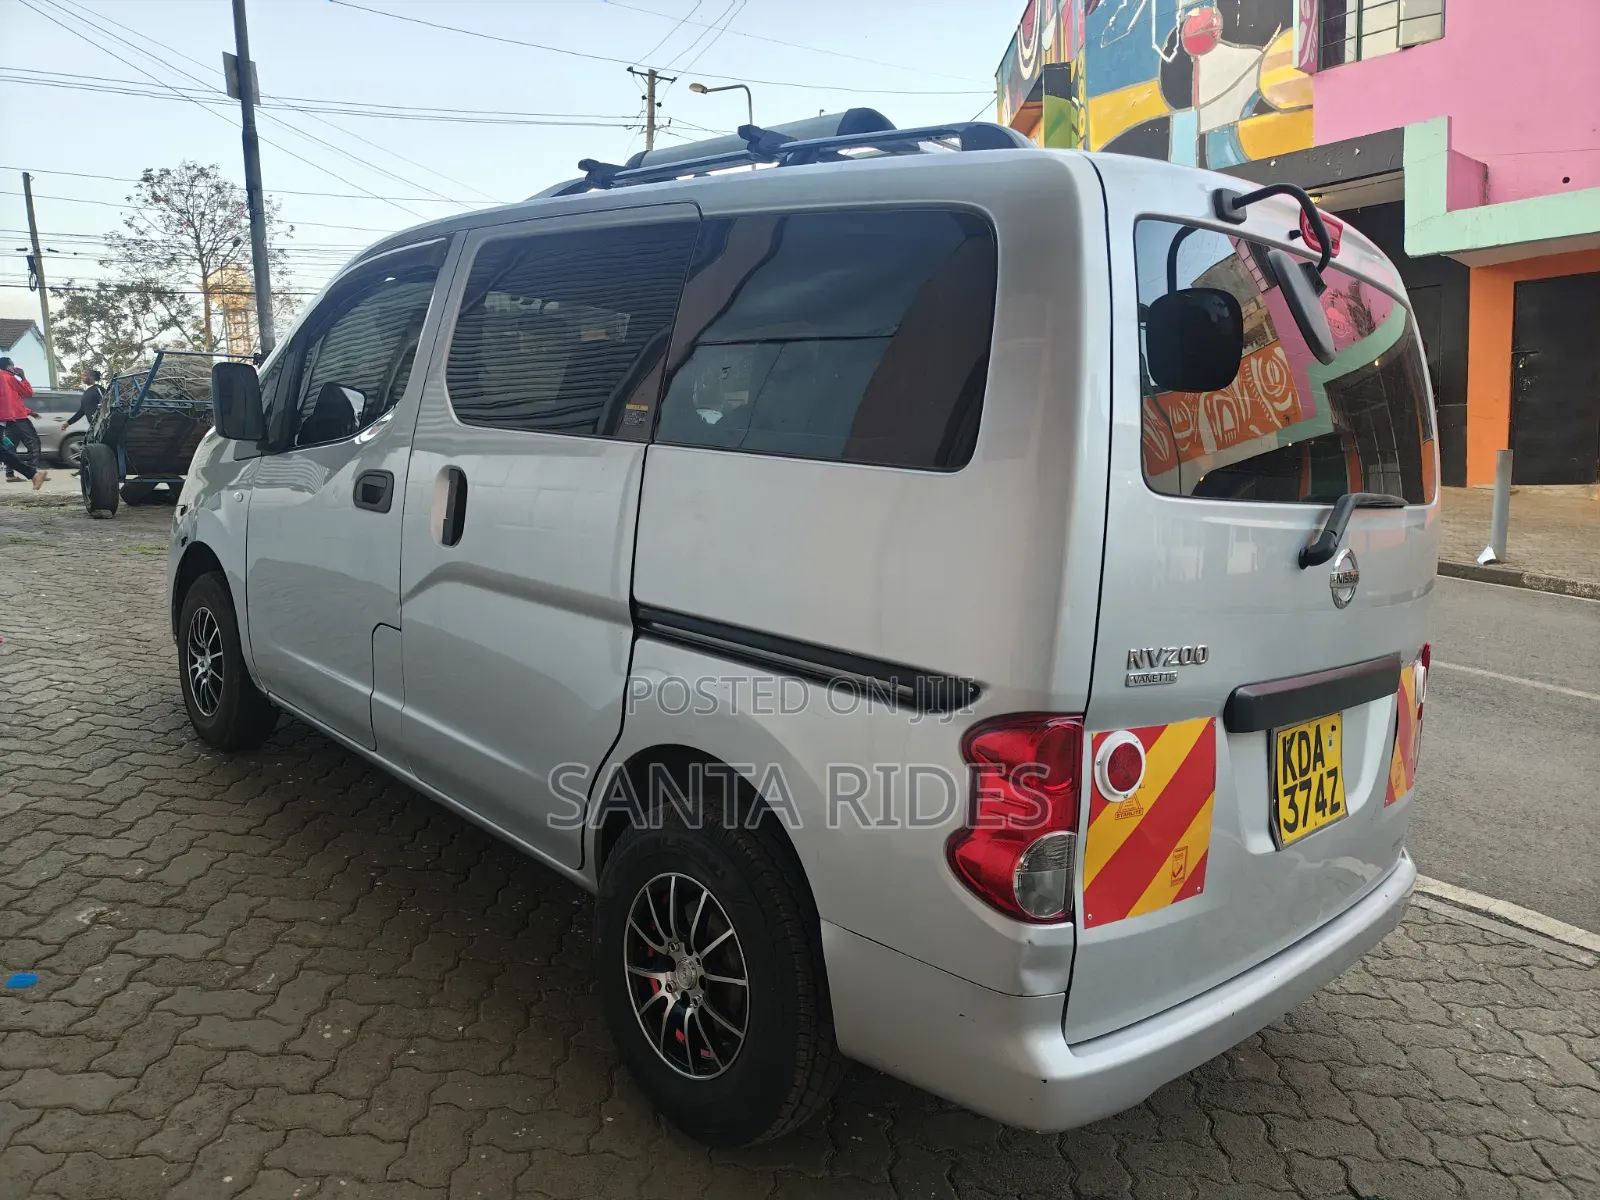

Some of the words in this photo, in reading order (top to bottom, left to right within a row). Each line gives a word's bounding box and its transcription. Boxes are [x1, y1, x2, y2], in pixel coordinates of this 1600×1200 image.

[1127, 645, 1209, 670] NV200
[1133, 673, 1177, 684] VANETTE
[1282, 724, 1325, 785] KDA
[1283, 766, 1341, 834] 374Z
